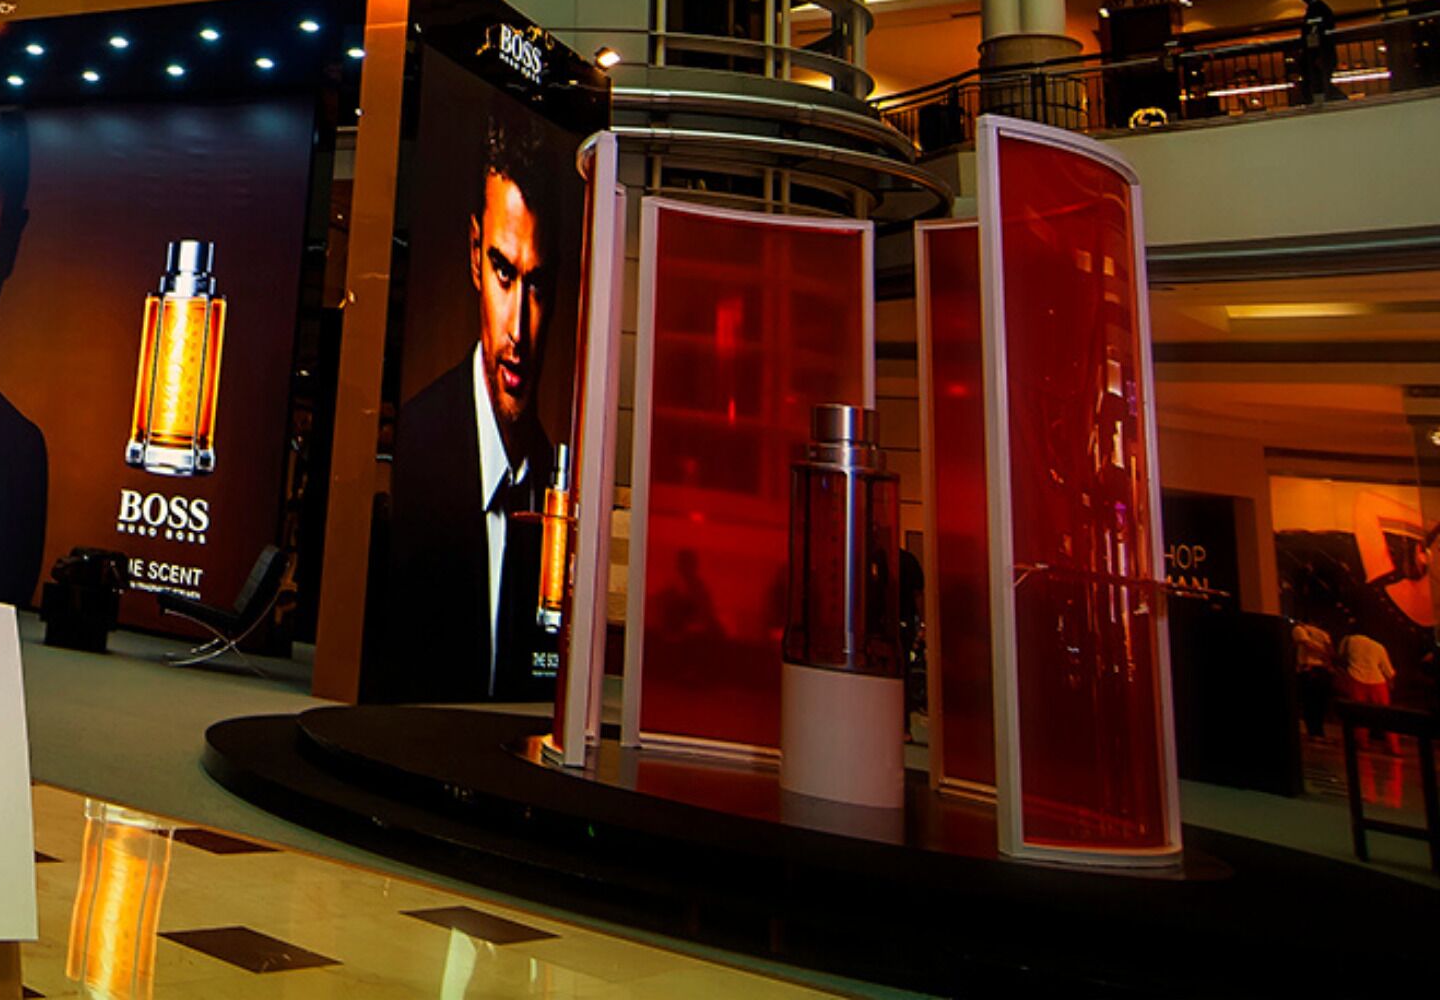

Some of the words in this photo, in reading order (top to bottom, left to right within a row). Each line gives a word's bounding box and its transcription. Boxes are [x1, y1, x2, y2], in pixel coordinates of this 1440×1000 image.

[500, 23, 542, 73] BOSS
[118, 489, 210, 532] BOSS
[147, 561, 203, 587] SCENT
[1163, 543, 1207, 570] HOP
